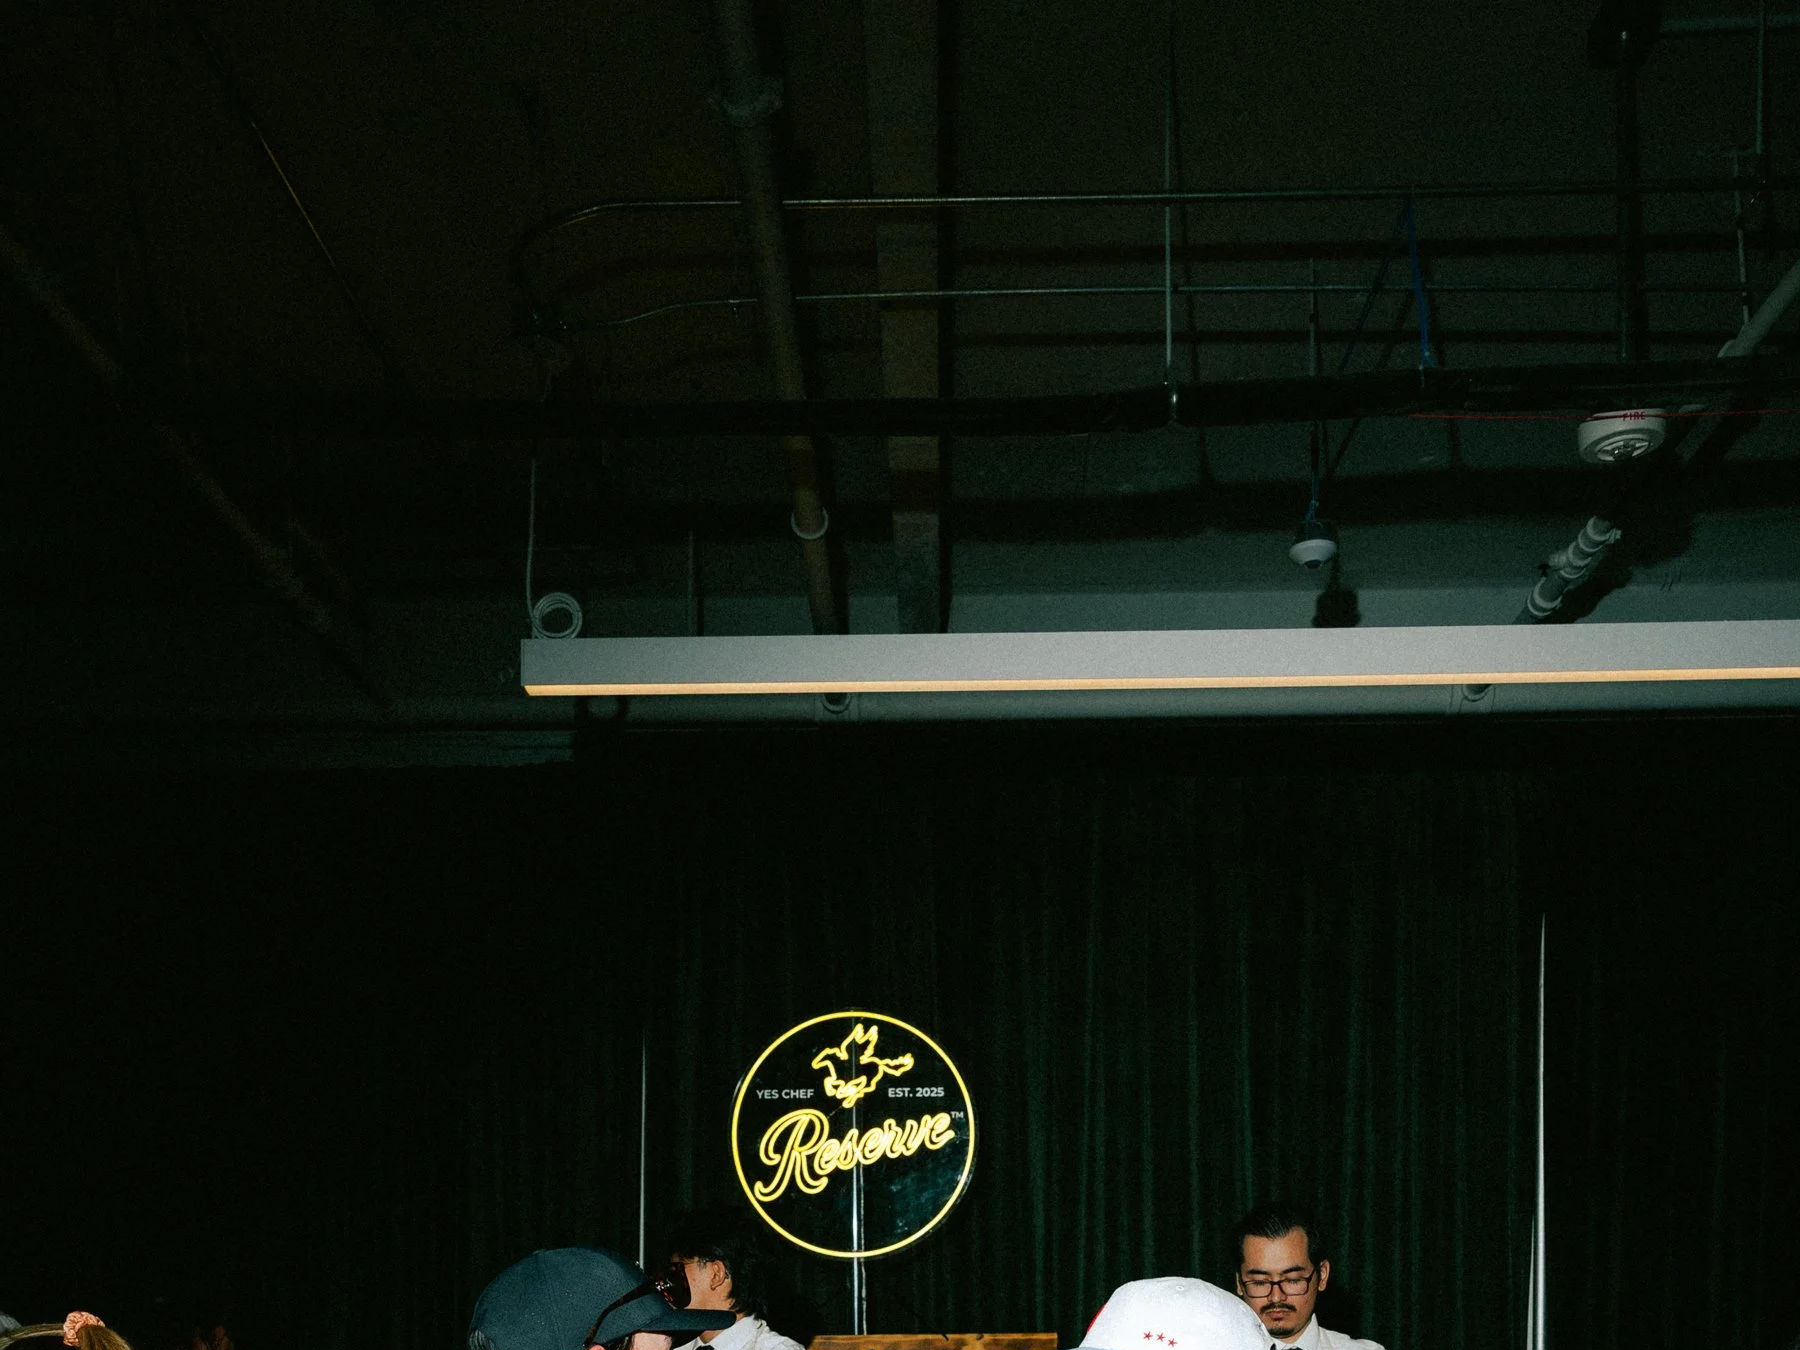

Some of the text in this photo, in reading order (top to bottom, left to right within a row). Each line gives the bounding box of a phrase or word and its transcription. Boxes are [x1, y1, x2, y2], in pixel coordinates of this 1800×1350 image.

[756, 1088, 814, 1099] YES CHEF
[888, 1087, 944, 1098] EST. 2025
[754, 1108, 955, 1202] Reserve
